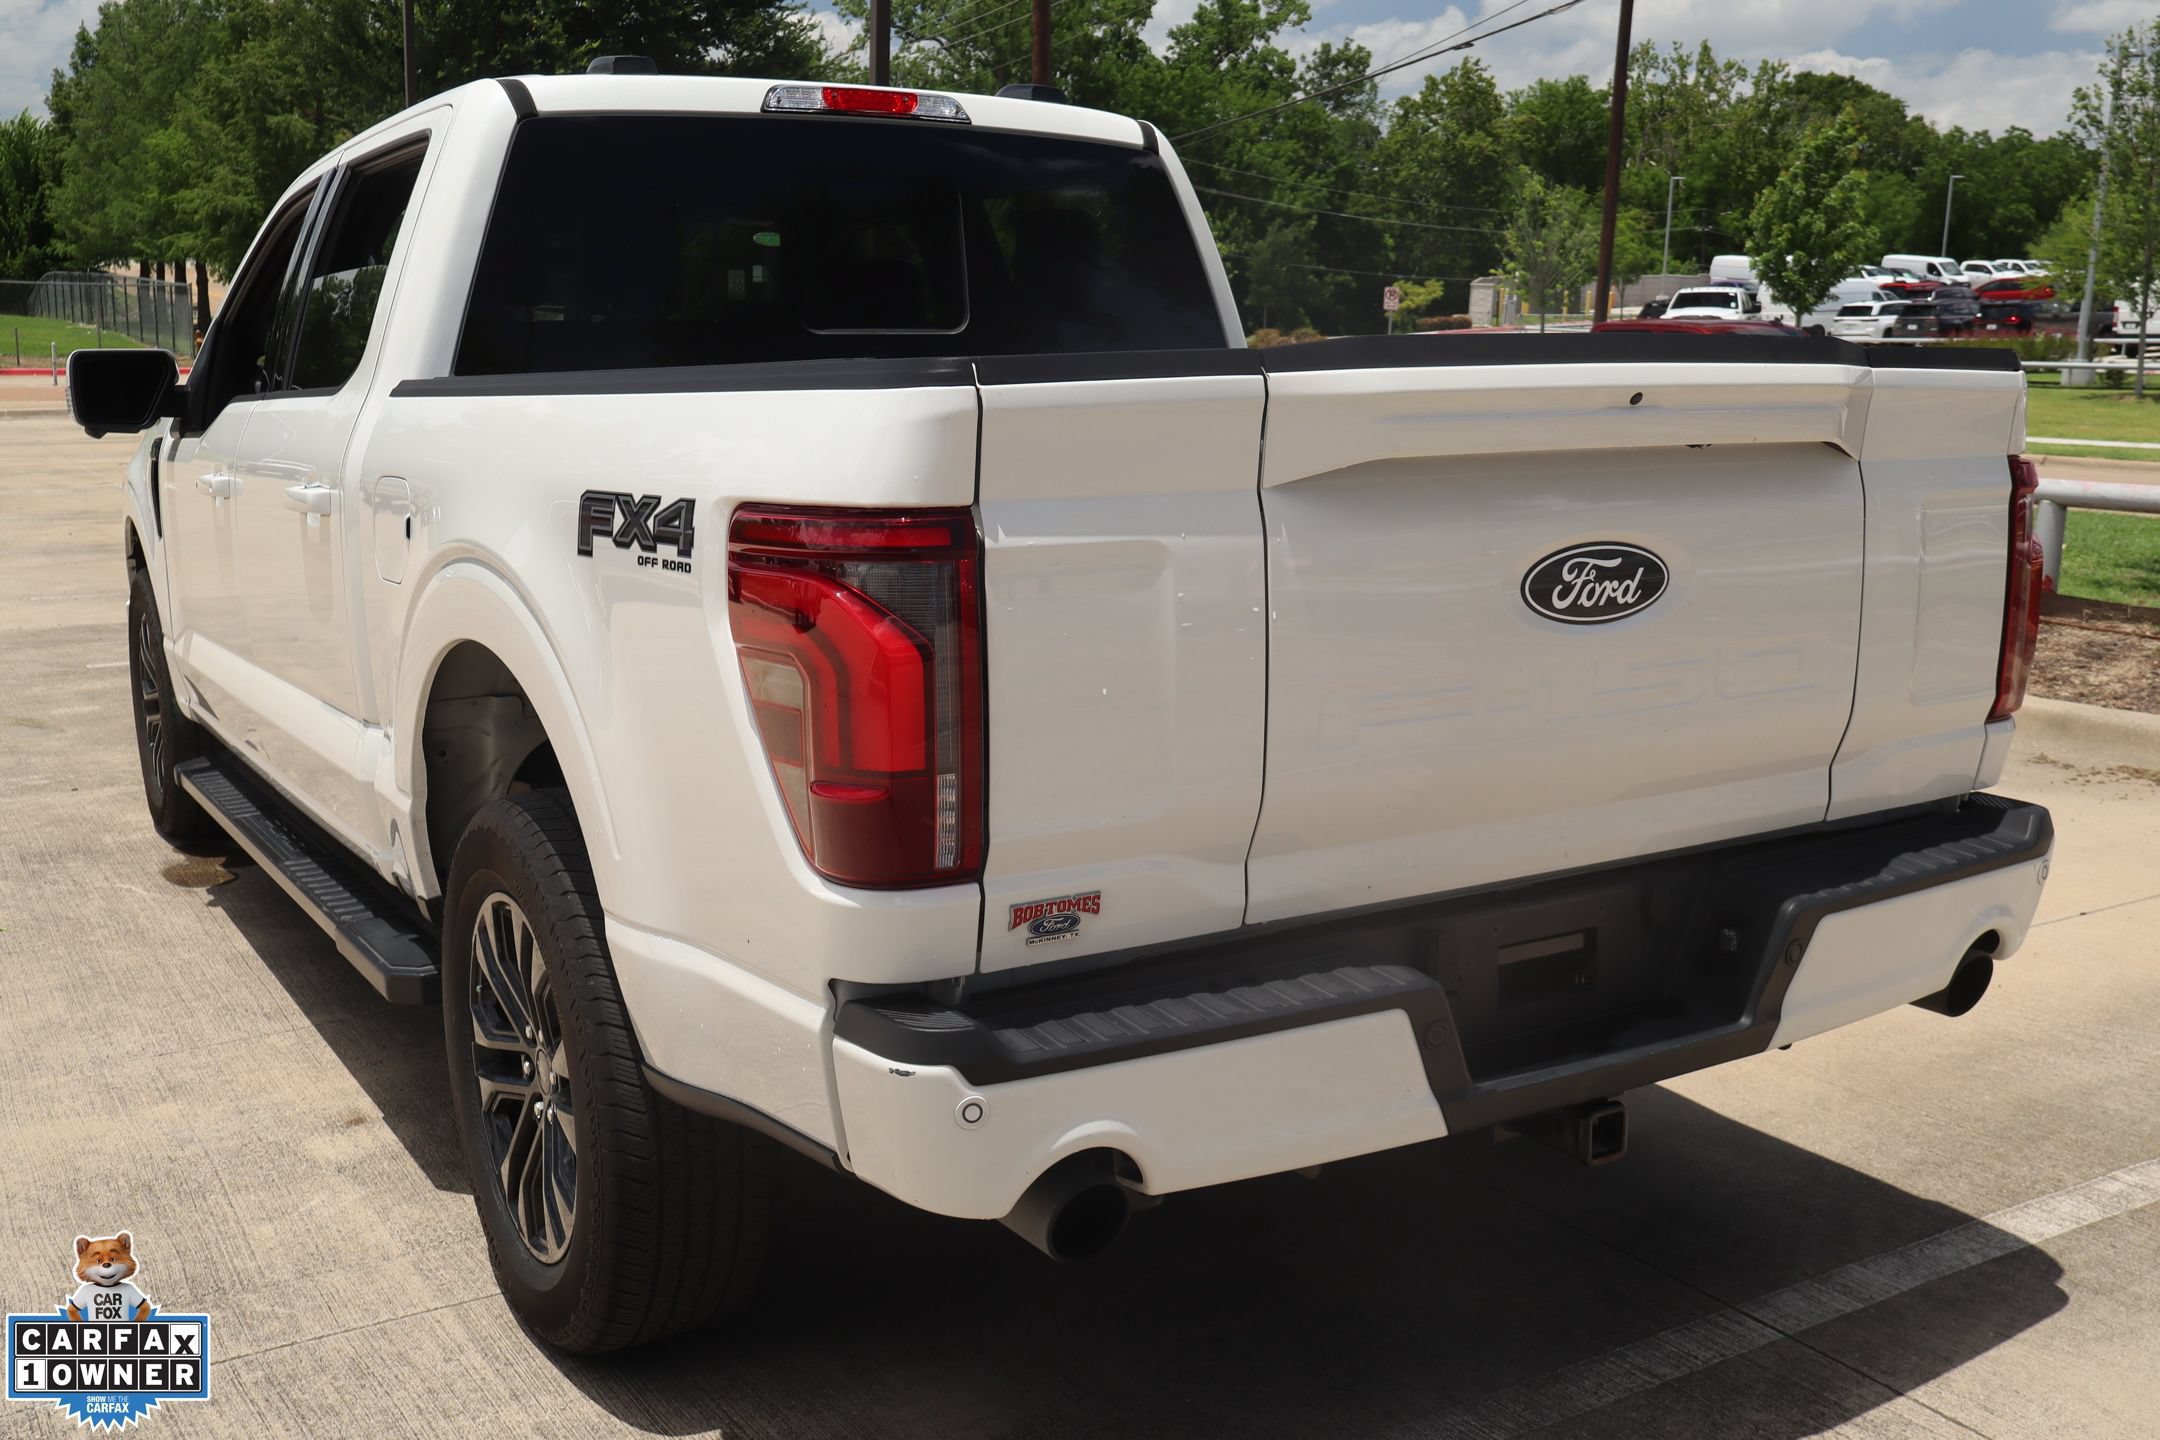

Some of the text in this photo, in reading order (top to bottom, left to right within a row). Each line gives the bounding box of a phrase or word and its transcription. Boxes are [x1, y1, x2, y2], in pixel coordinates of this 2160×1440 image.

[577, 489, 696, 559] FX4
[637, 555, 692, 574] OFF ROAD
[1552, 557, 1645, 610] Ford
[1011, 894, 1101, 930] BOB TOMES
[1039, 917, 1072, 933] Ford
